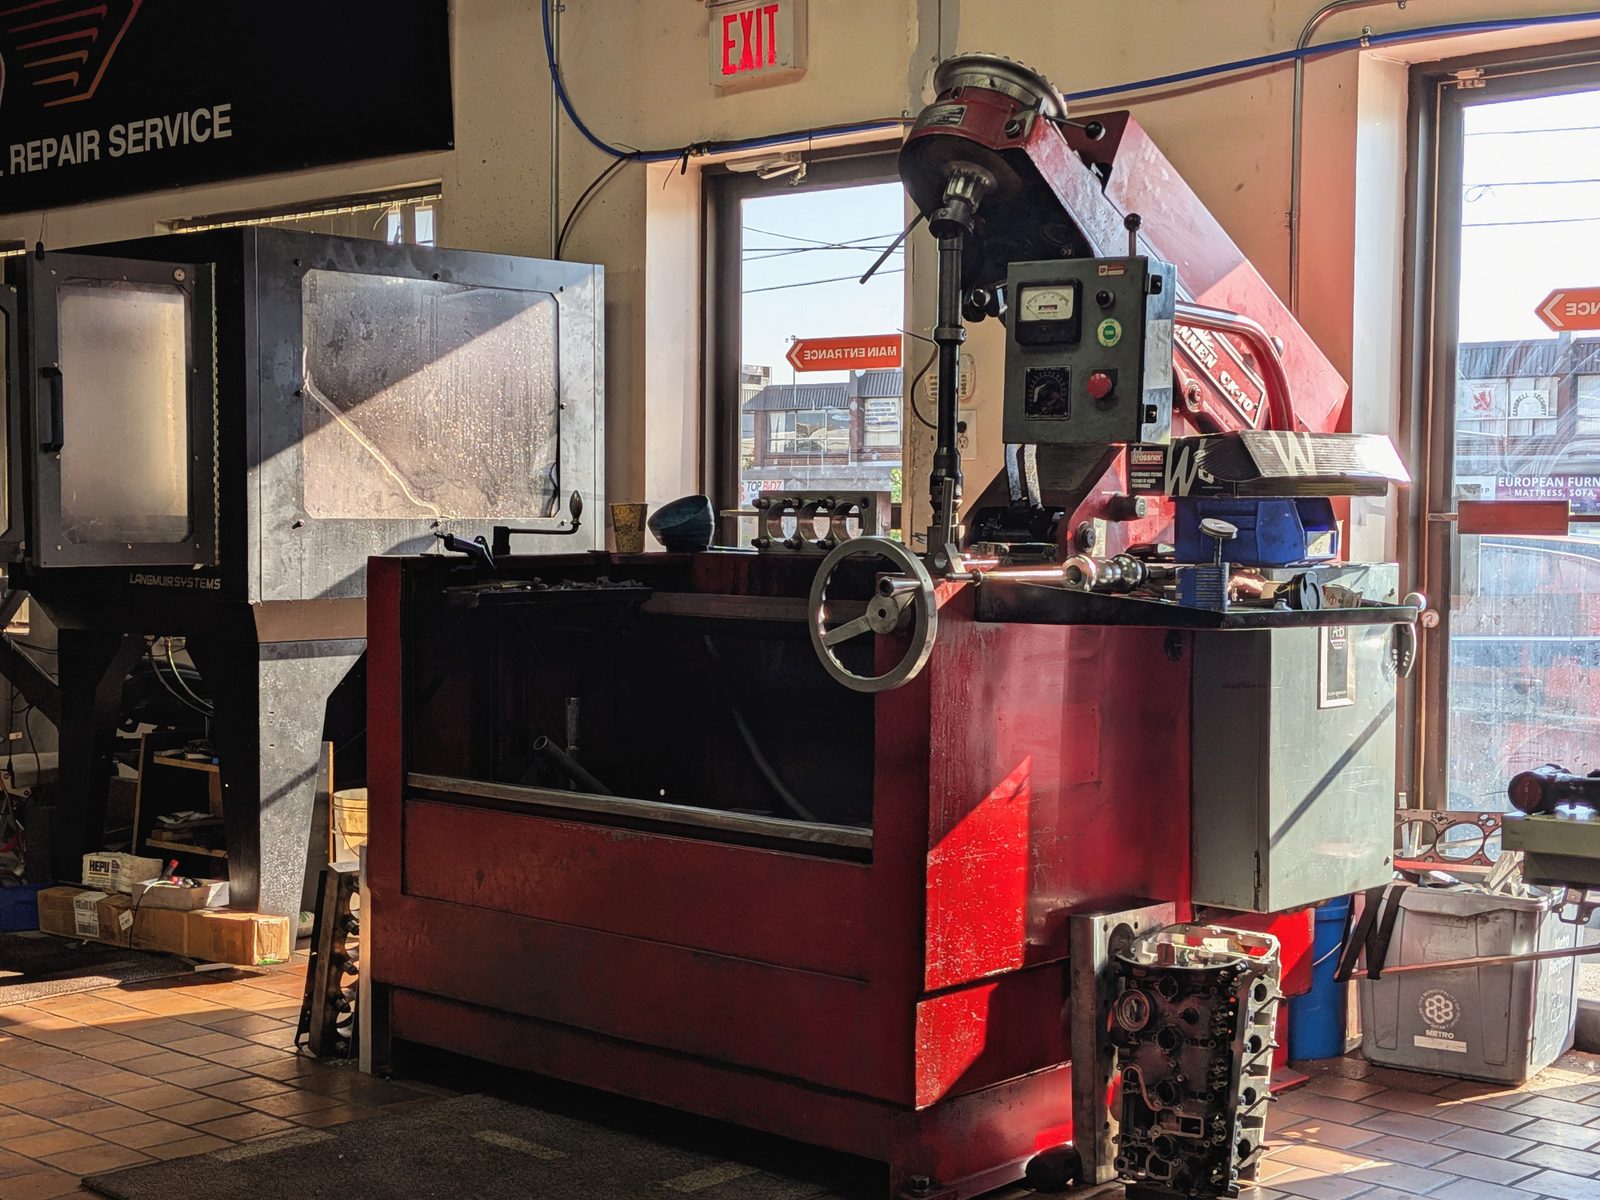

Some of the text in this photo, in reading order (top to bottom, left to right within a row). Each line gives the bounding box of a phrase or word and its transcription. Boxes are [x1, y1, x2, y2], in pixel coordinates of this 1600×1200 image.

[722, 4, 779, 75] EXIT
[9, 103, 232, 175] REPAIR SERVICE
[746, 481, 763, 492] TOP
[1498, 477, 1564, 487] EUROPEAN
[1425, 1030, 1455, 1039] METRO
